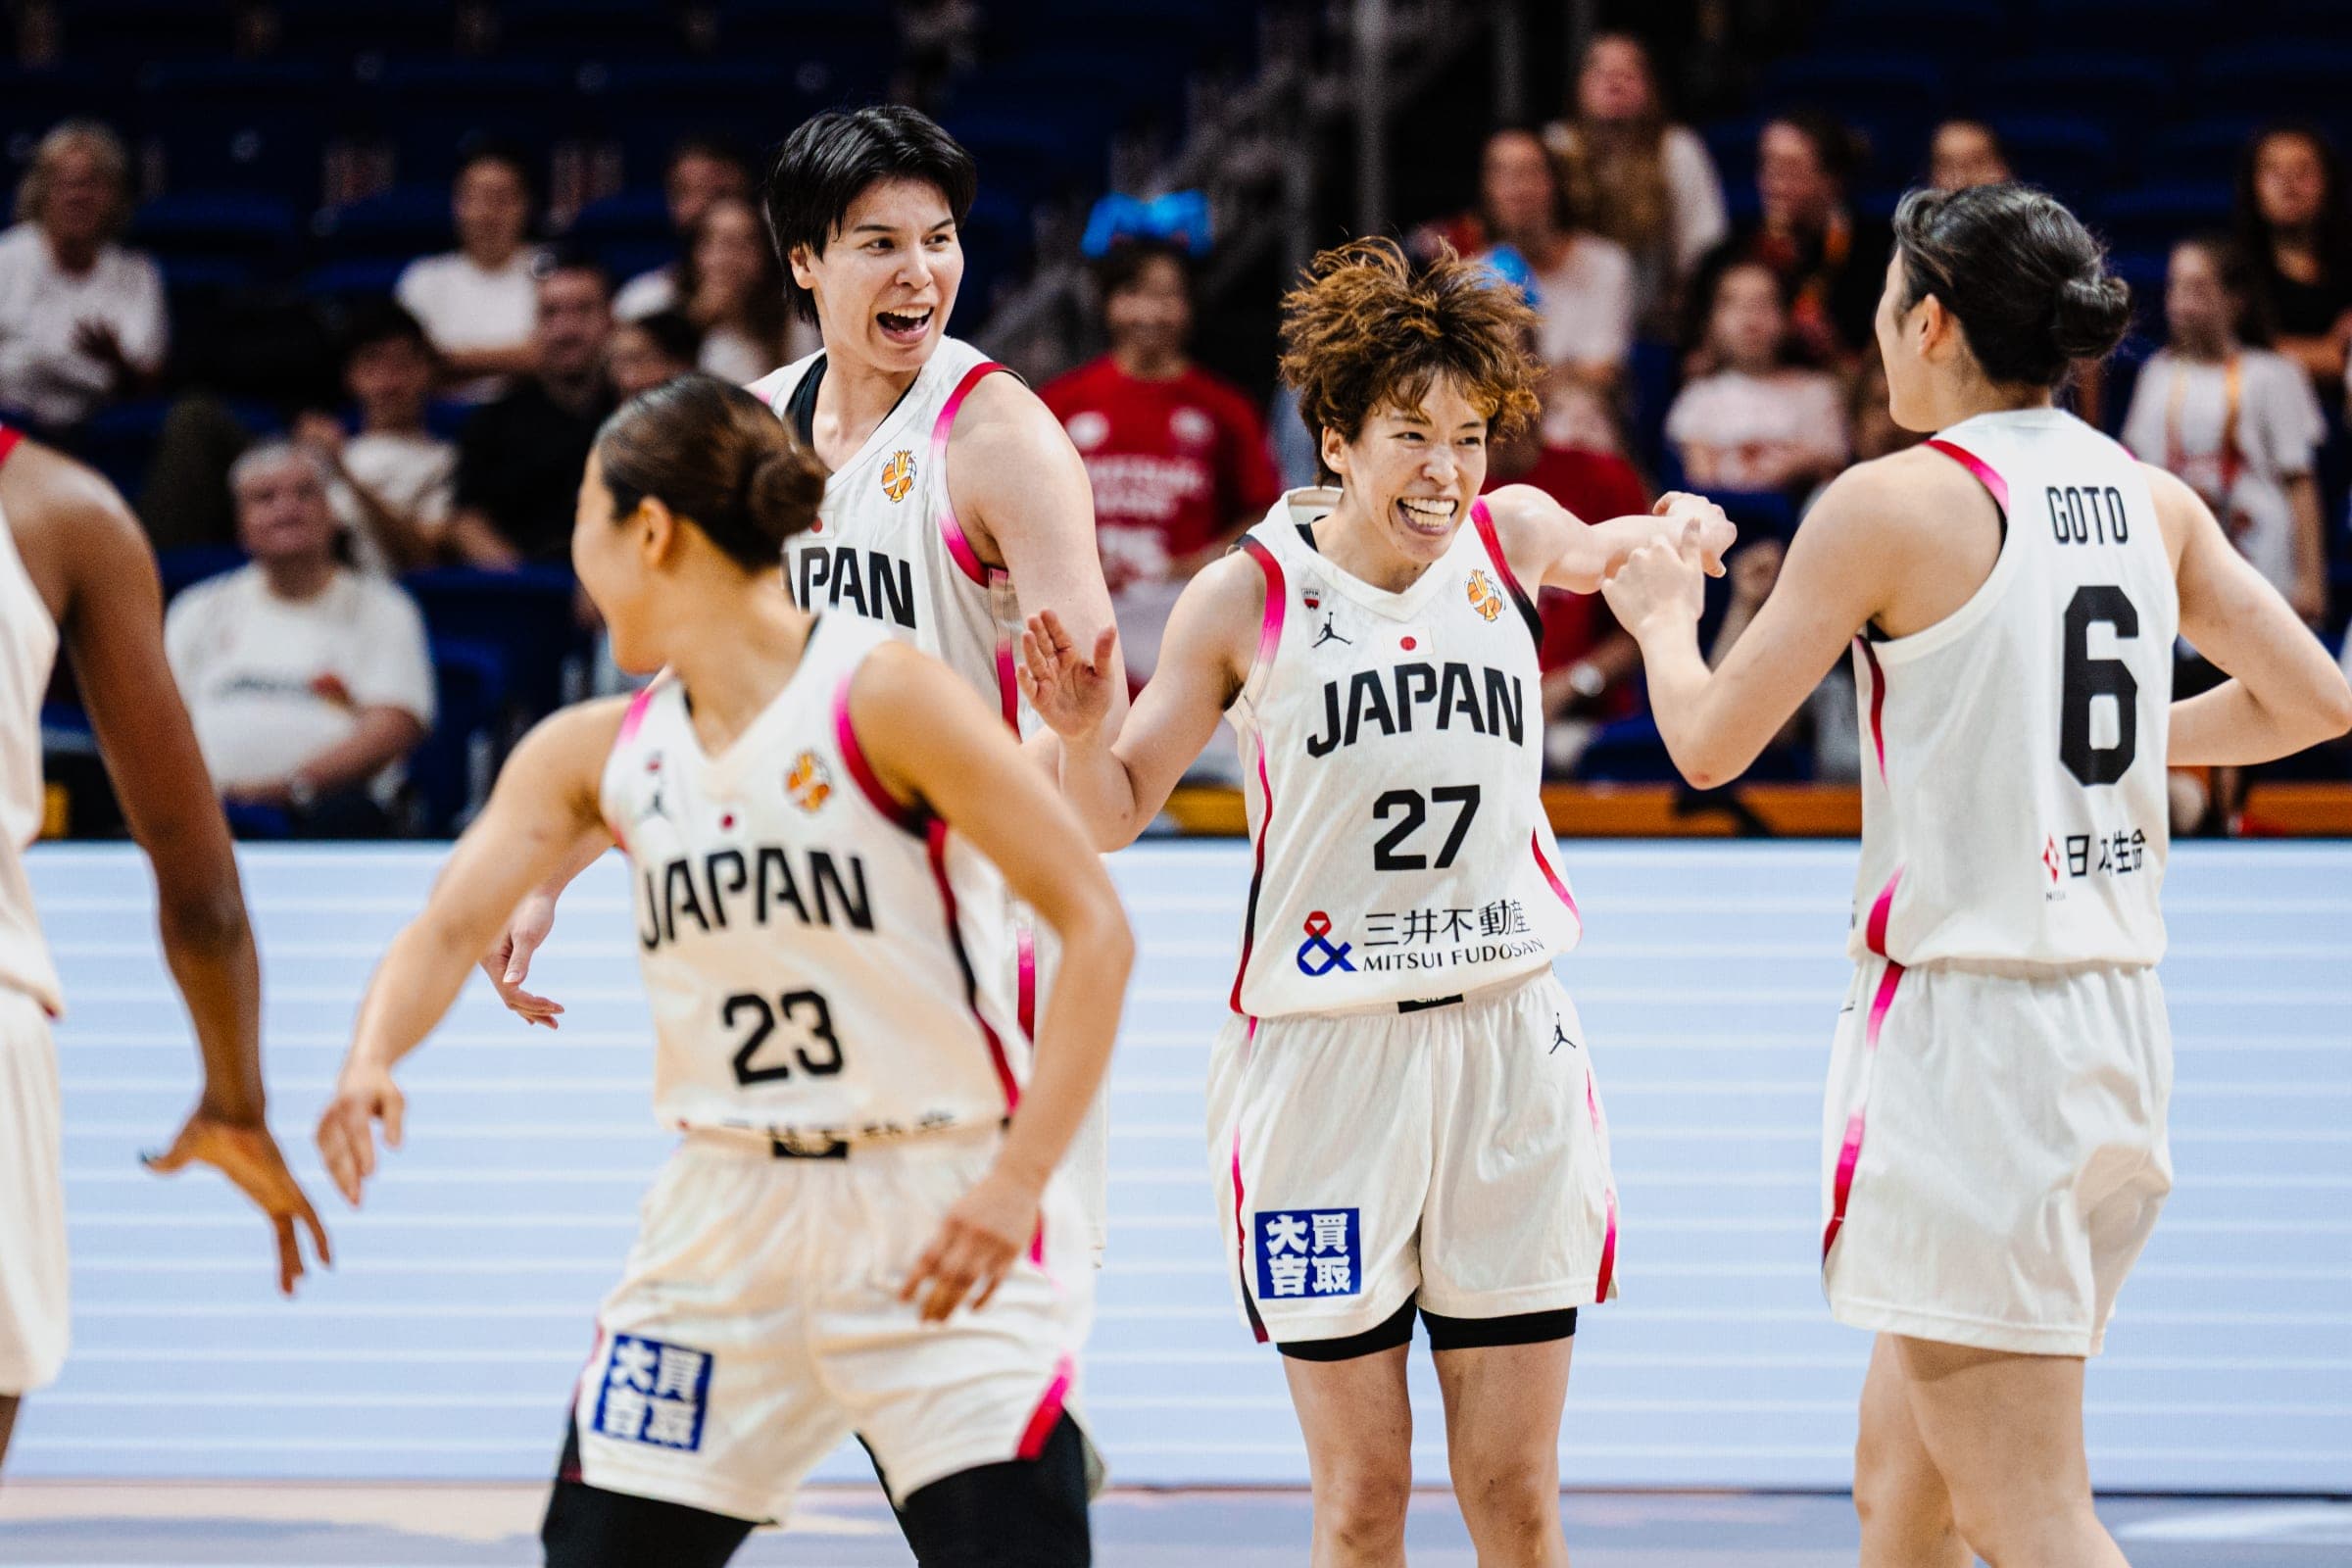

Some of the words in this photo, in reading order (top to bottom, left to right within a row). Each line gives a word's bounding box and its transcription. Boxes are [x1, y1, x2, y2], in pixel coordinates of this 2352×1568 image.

[2046, 486, 2130, 545] GOTO
[783, 547, 916, 629] PAN
[1306, 662, 1524, 759] JAPAN
[2059, 585, 2139, 787] 6
[1372, 784, 1482, 871] 27
[641, 847, 874, 952] JAPAN
[1363, 900, 1531, 947] 三井不動産
[1363, 952, 1444, 971] MITSUI
[1451, 937, 1545, 966] FUDOSAN
[721, 989, 844, 1086] 23
